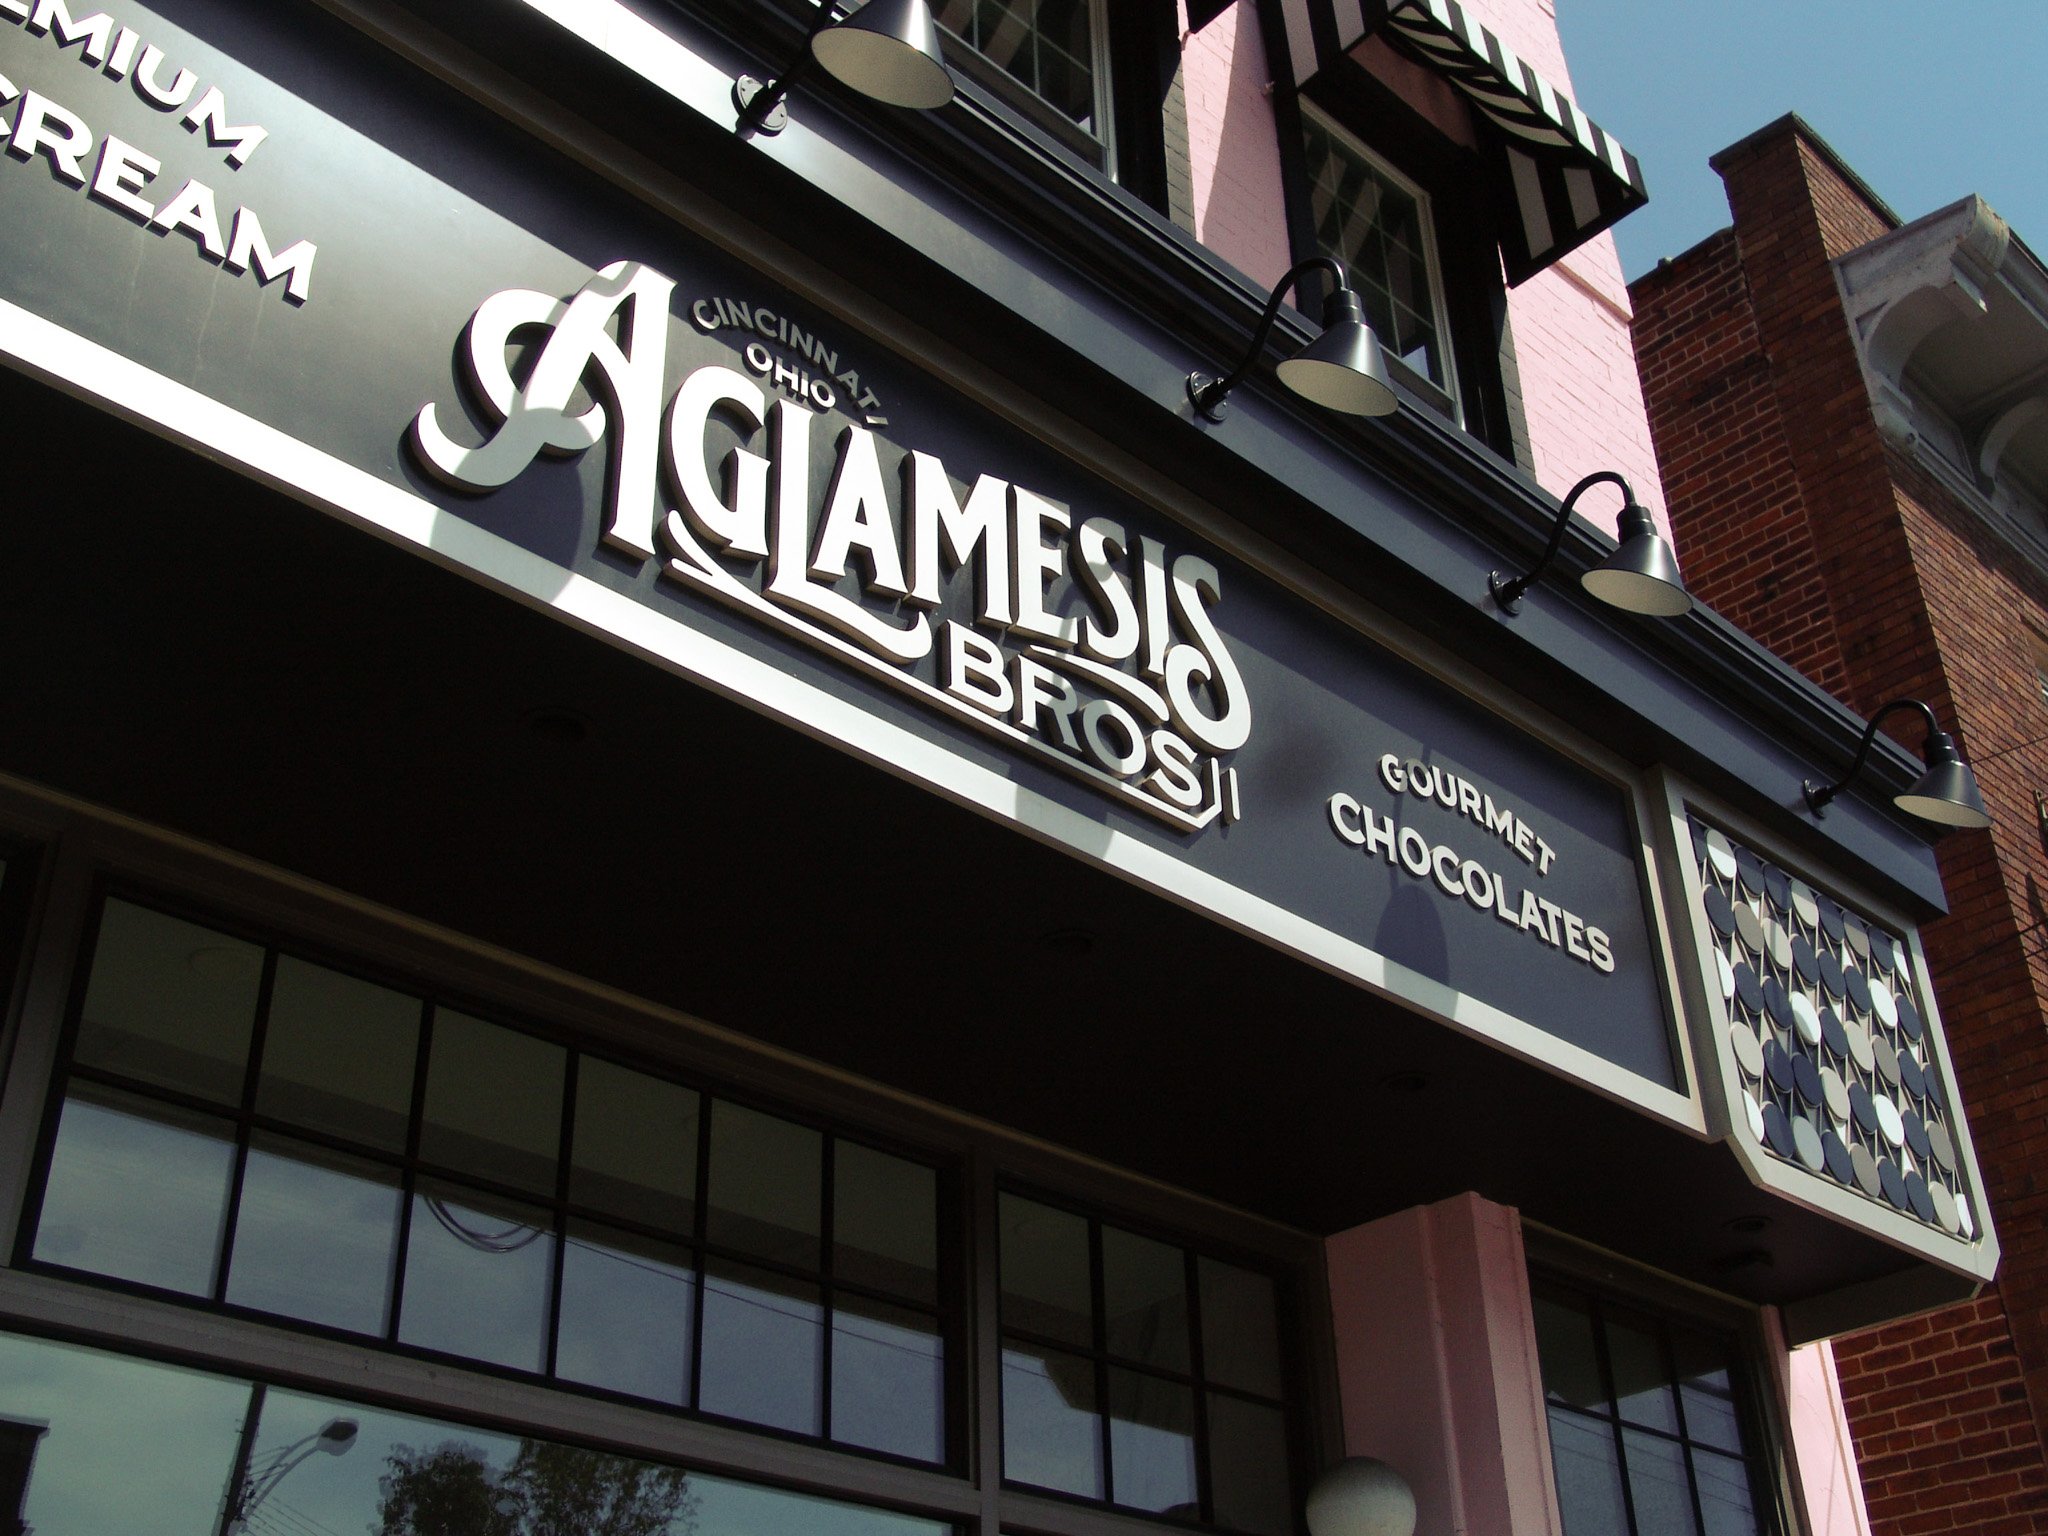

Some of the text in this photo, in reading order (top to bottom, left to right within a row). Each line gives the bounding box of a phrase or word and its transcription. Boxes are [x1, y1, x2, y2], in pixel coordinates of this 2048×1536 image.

[0, 0, 269, 170] MIUM
[690, 297, 889, 426] CINCINNATI
[746, 342, 836, 408] OHIO
[412, 260, 1252, 752] AGLAMESIS
[945, 619, 1203, 808] BROS
[1328, 792, 1615, 973] CHOCOLATES
[1380, 754, 1556, 876] GOURMET
